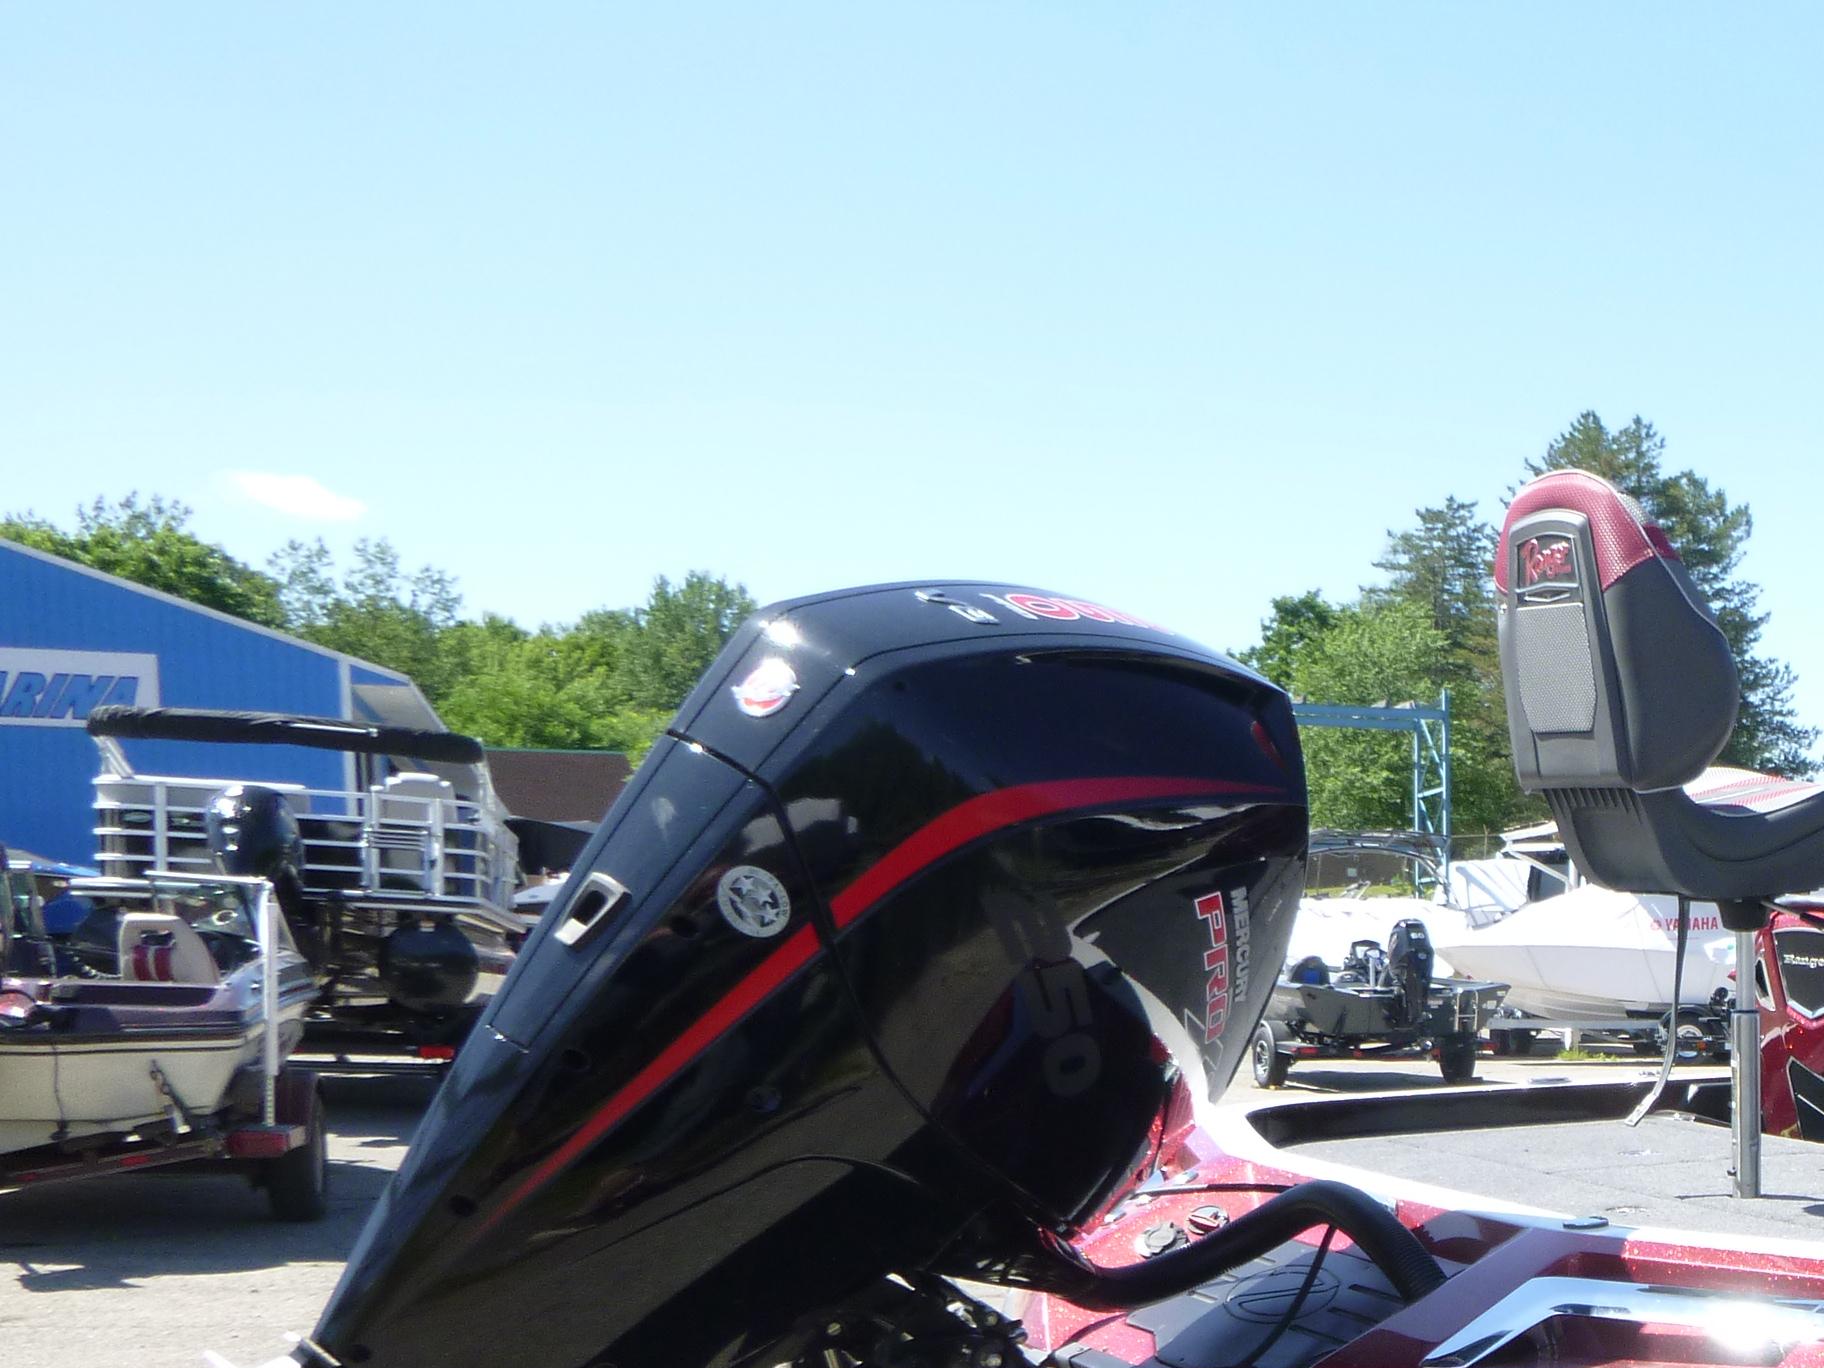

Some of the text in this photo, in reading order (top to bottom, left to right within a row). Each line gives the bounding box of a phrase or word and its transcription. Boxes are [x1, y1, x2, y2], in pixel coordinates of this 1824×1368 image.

[1195, 890, 1230, 1045] PRO
[1230, 886, 1251, 1002] MERCURY
[1665, 916, 1719, 932] YAAHA
